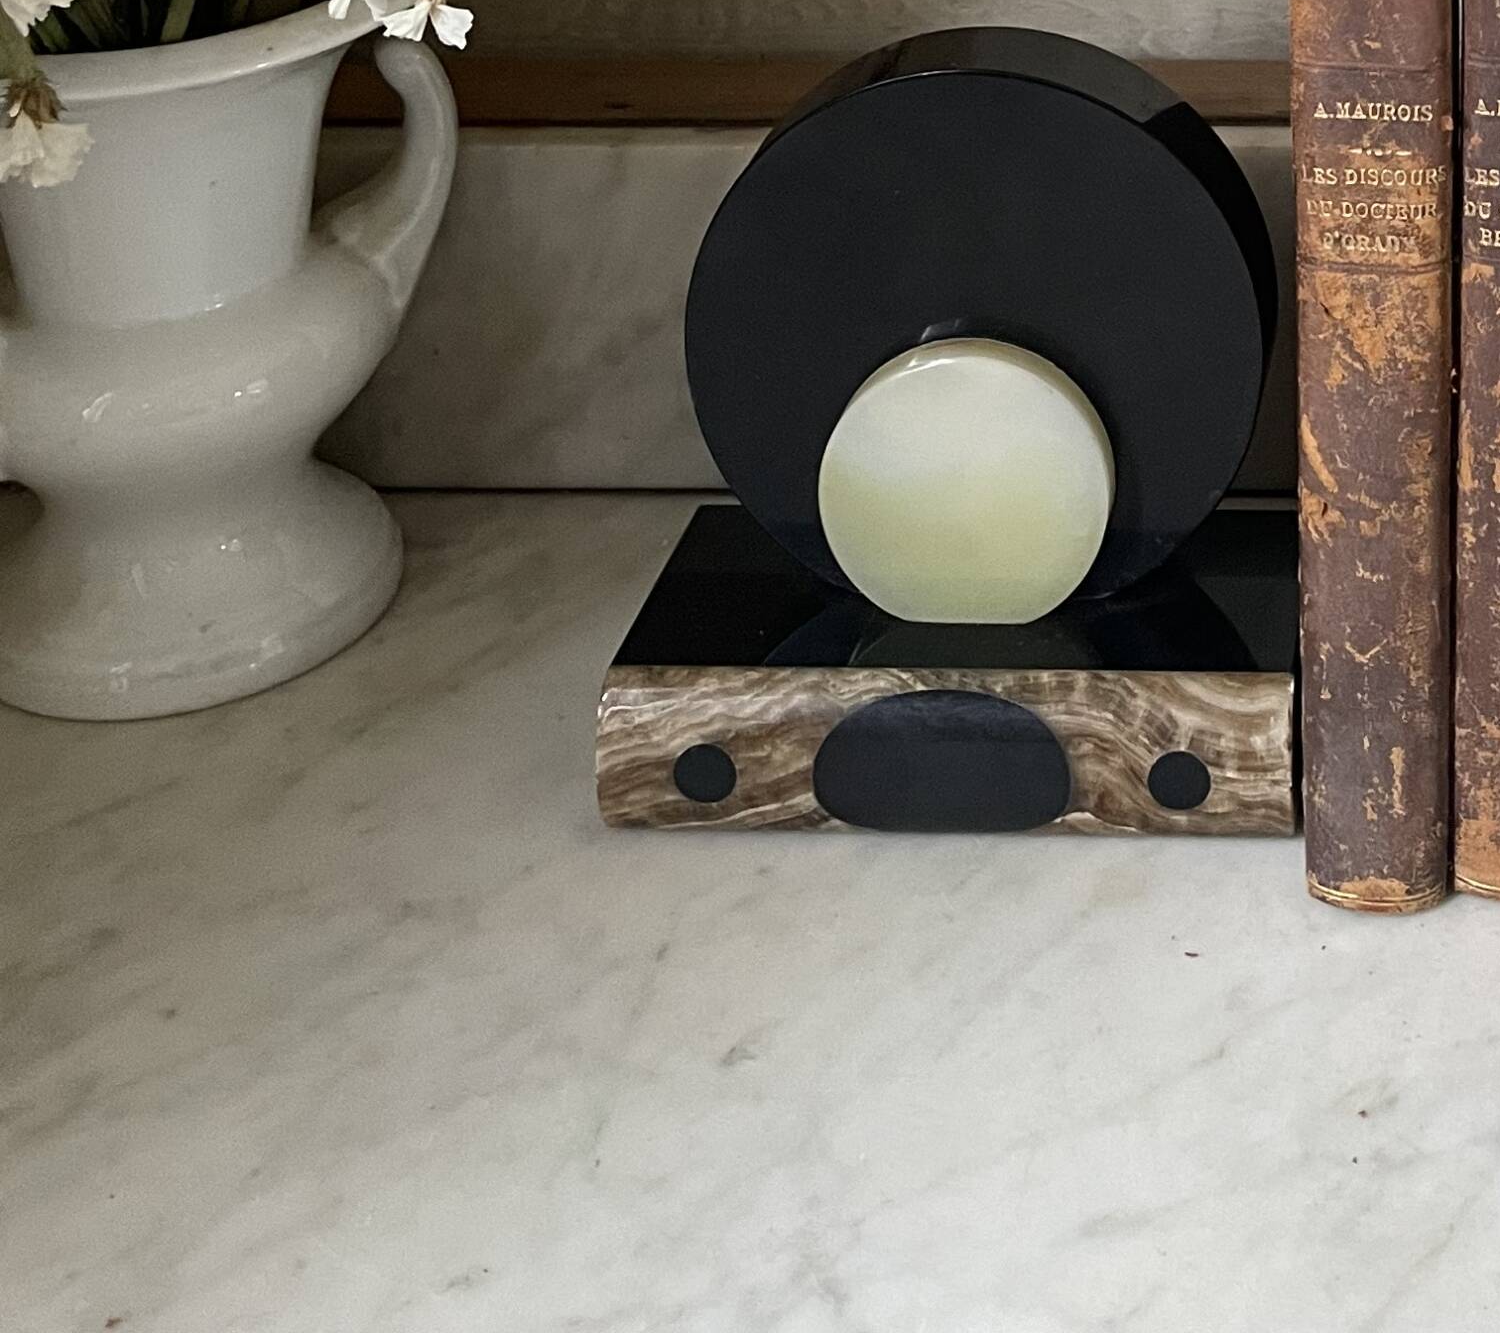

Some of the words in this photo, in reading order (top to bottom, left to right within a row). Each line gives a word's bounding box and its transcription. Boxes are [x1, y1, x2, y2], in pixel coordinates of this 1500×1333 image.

[1313, 101, 1433, 122] A.MAUROIS
[1301, 163, 1338, 186] LES
[1343, 164, 1446, 187] DISCOURS
[1464, 165, 1500, 186] LES
[1463, 196, 1492, 219] DU
